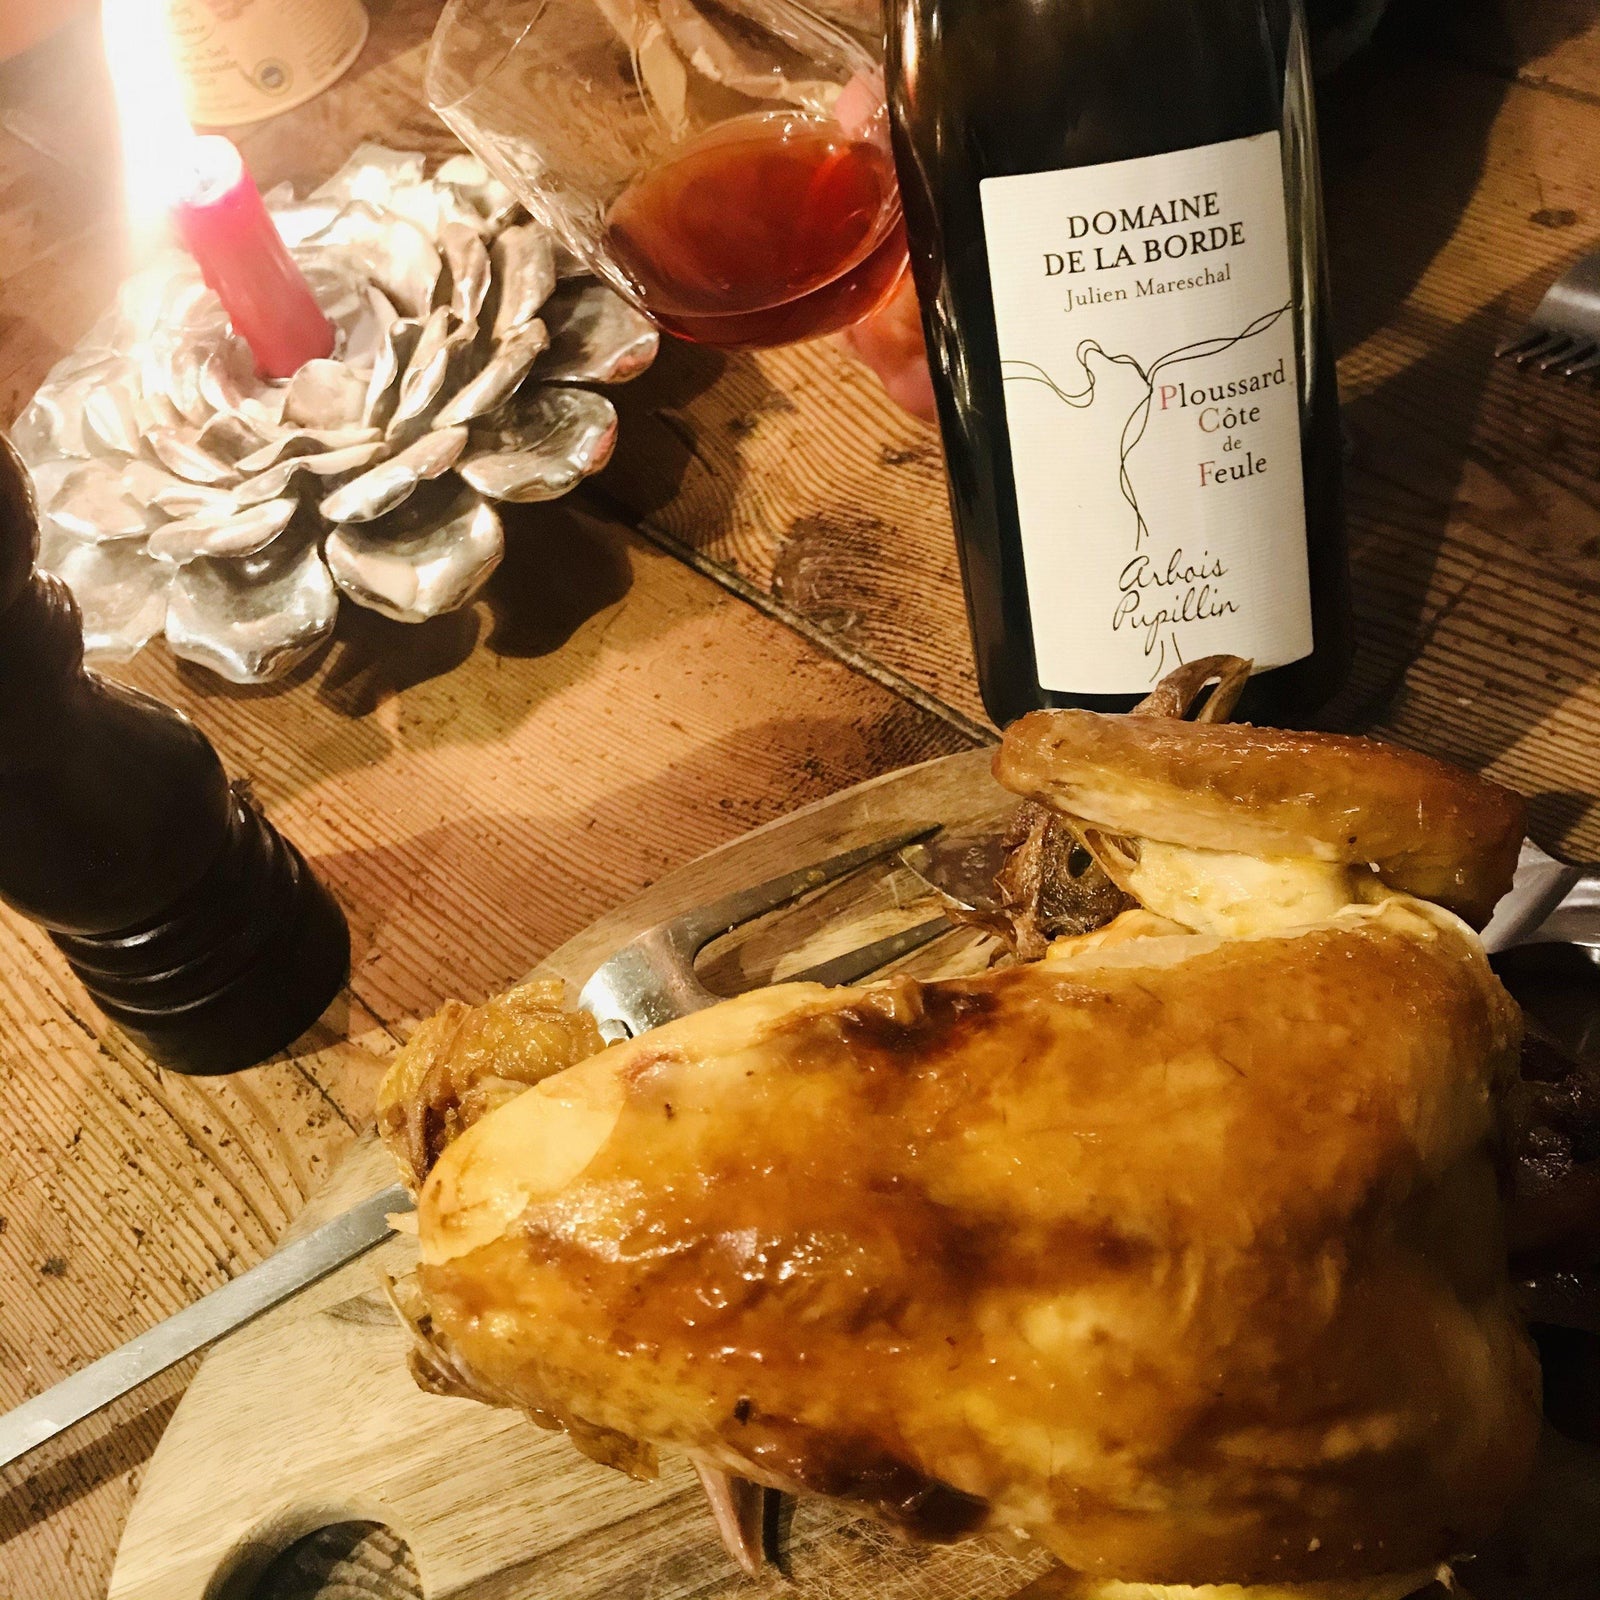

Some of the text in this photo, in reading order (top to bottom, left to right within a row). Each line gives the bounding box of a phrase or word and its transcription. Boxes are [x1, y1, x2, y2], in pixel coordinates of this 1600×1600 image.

[1066, 191, 1221, 240] DOMAINE
[1043, 221, 1247, 277] DE LA BORDE
[1063, 263, 1233, 313] Julien Mareschal
[1157, 358, 1287, 411] Ploussard
[1198, 406, 1262, 434] Côte
[1221, 435, 1243, 453] de
[1198, 451, 1268, 488] Feule
[1112, 583, 1241, 657] Pupillin
